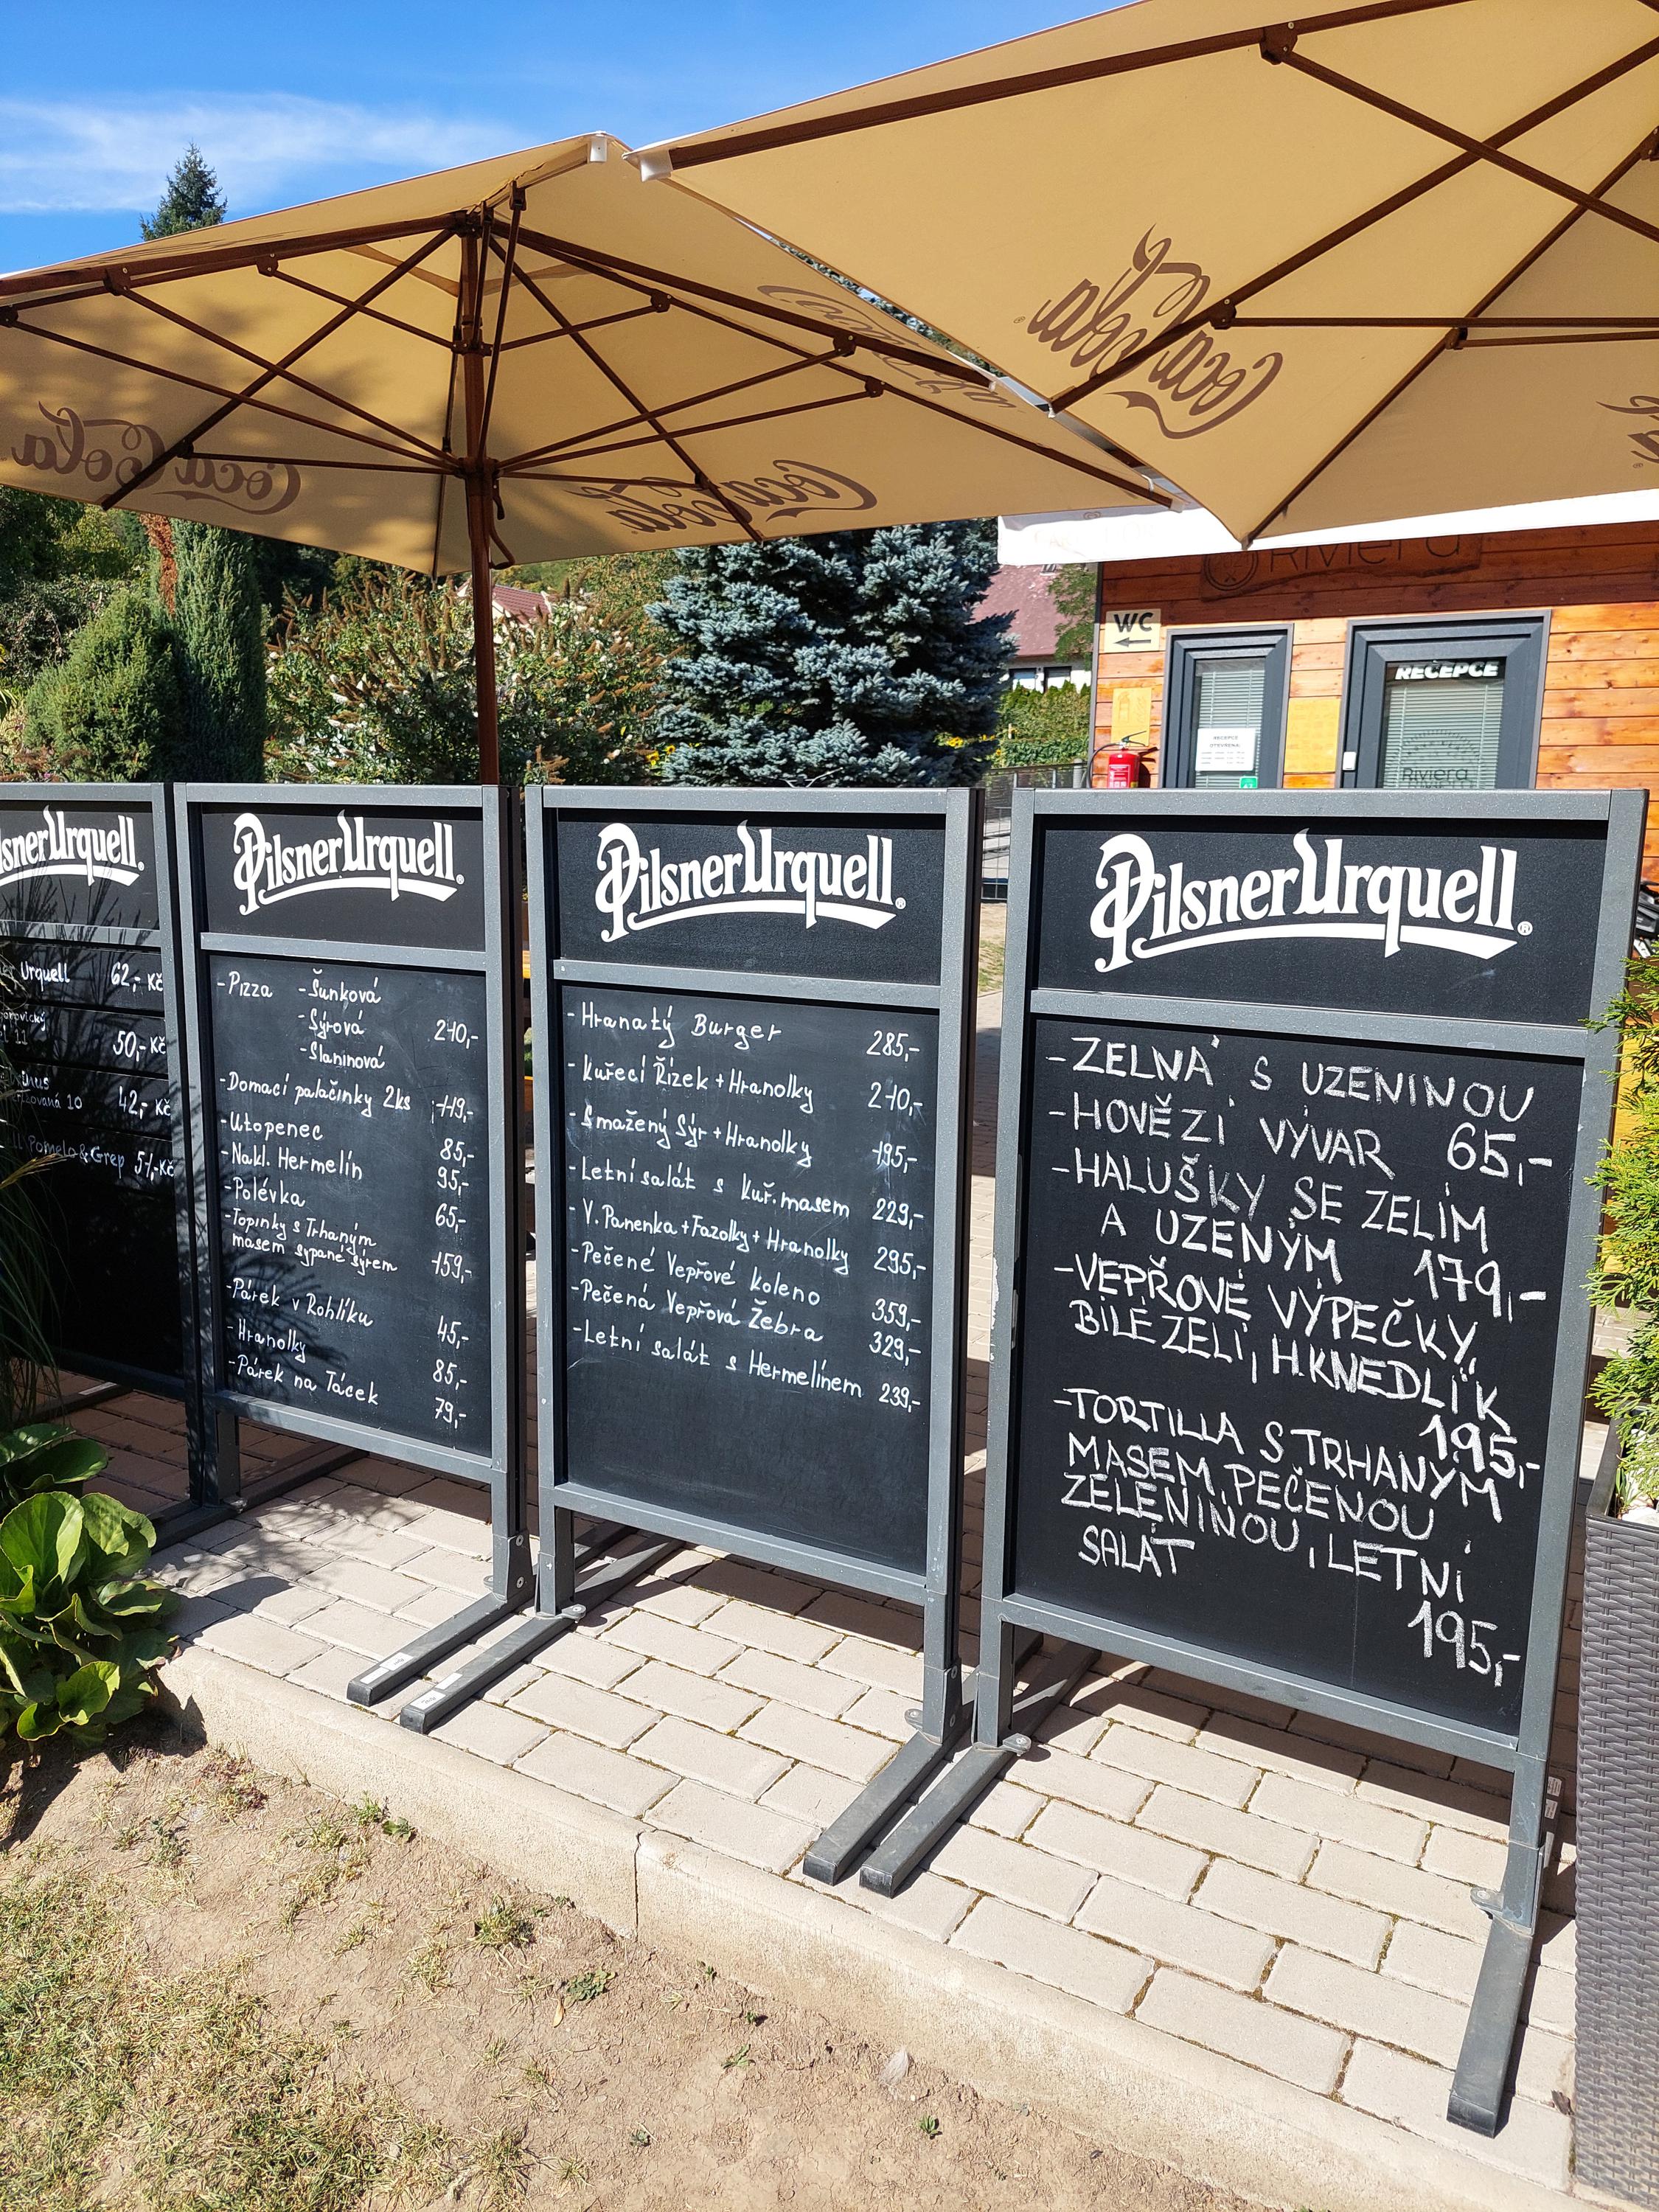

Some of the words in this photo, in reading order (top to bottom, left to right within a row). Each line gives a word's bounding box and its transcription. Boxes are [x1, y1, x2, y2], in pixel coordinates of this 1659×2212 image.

[1113, 612, 1154, 633] WC
[233, 813, 344, 916] Pilsner
[337, 810, 456, 902] Urquell
[595, 823, 743, 943] Pilsner
[737, 819, 894, 929] Urquell
[1090, 833, 1301, 973] Pilsner
[1293, 828, 1519, 958] Urquell
[21, 961, 70, 992] Urquell
